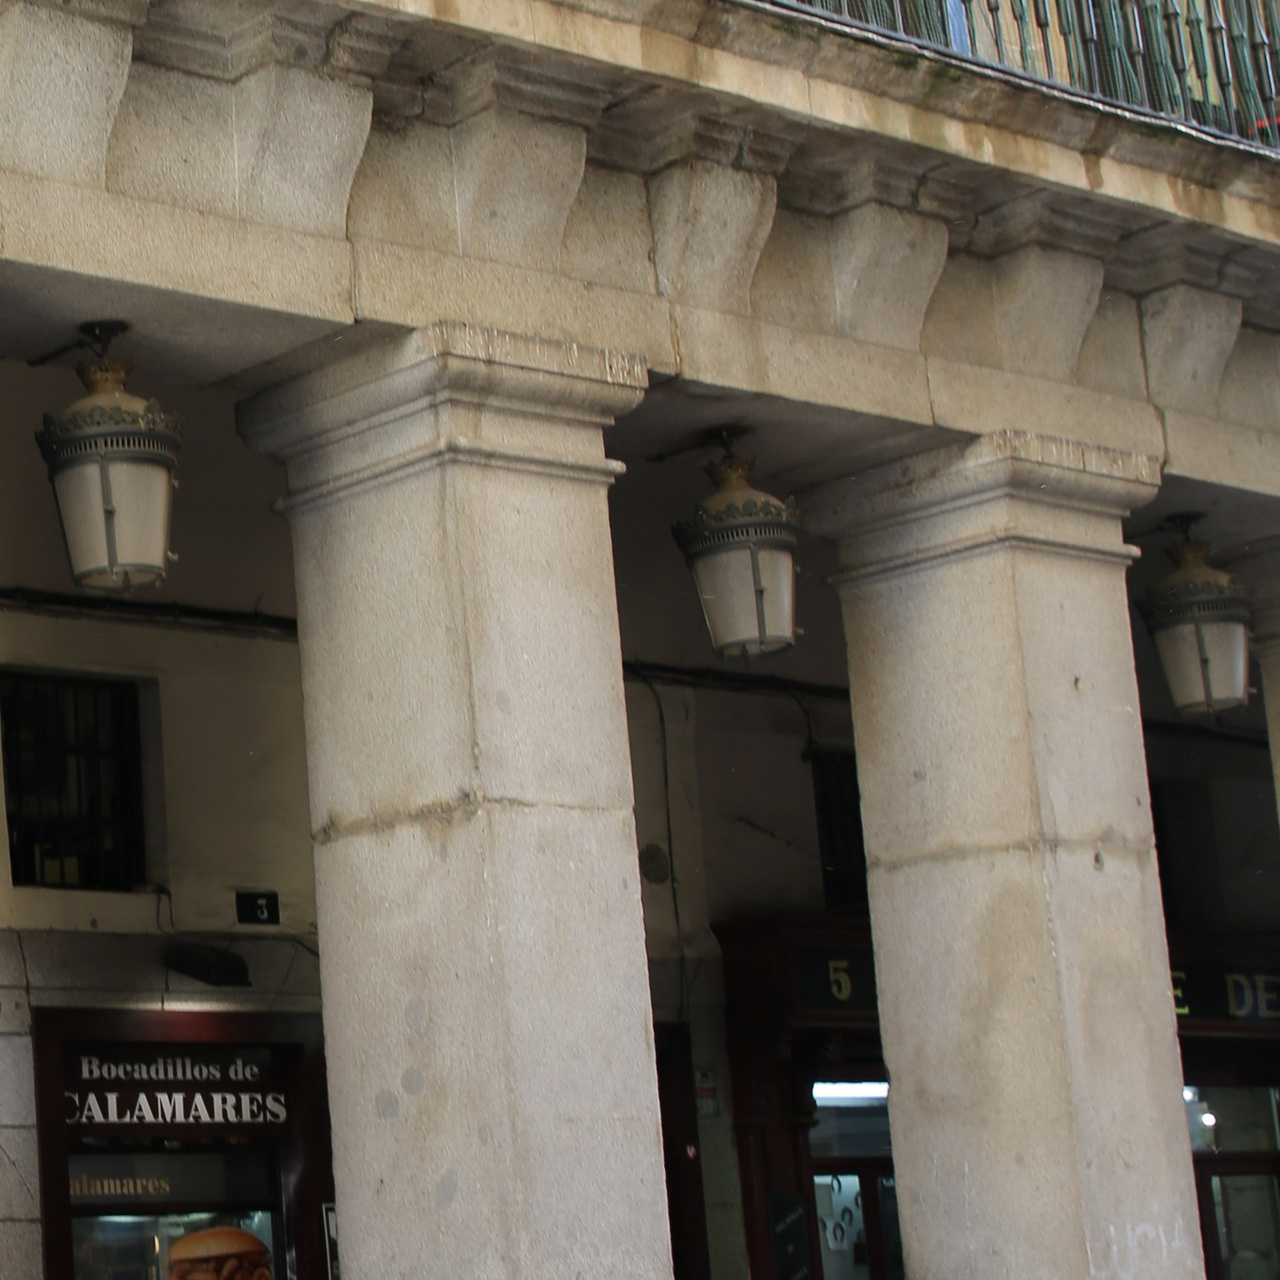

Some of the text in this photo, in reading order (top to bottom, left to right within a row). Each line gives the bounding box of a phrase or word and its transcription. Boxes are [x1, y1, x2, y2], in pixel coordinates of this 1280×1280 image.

[257, 898, 269, 921] 3
[827, 958, 852, 1002] 5
[80, 1055, 260, 1082] Bocadillos de
